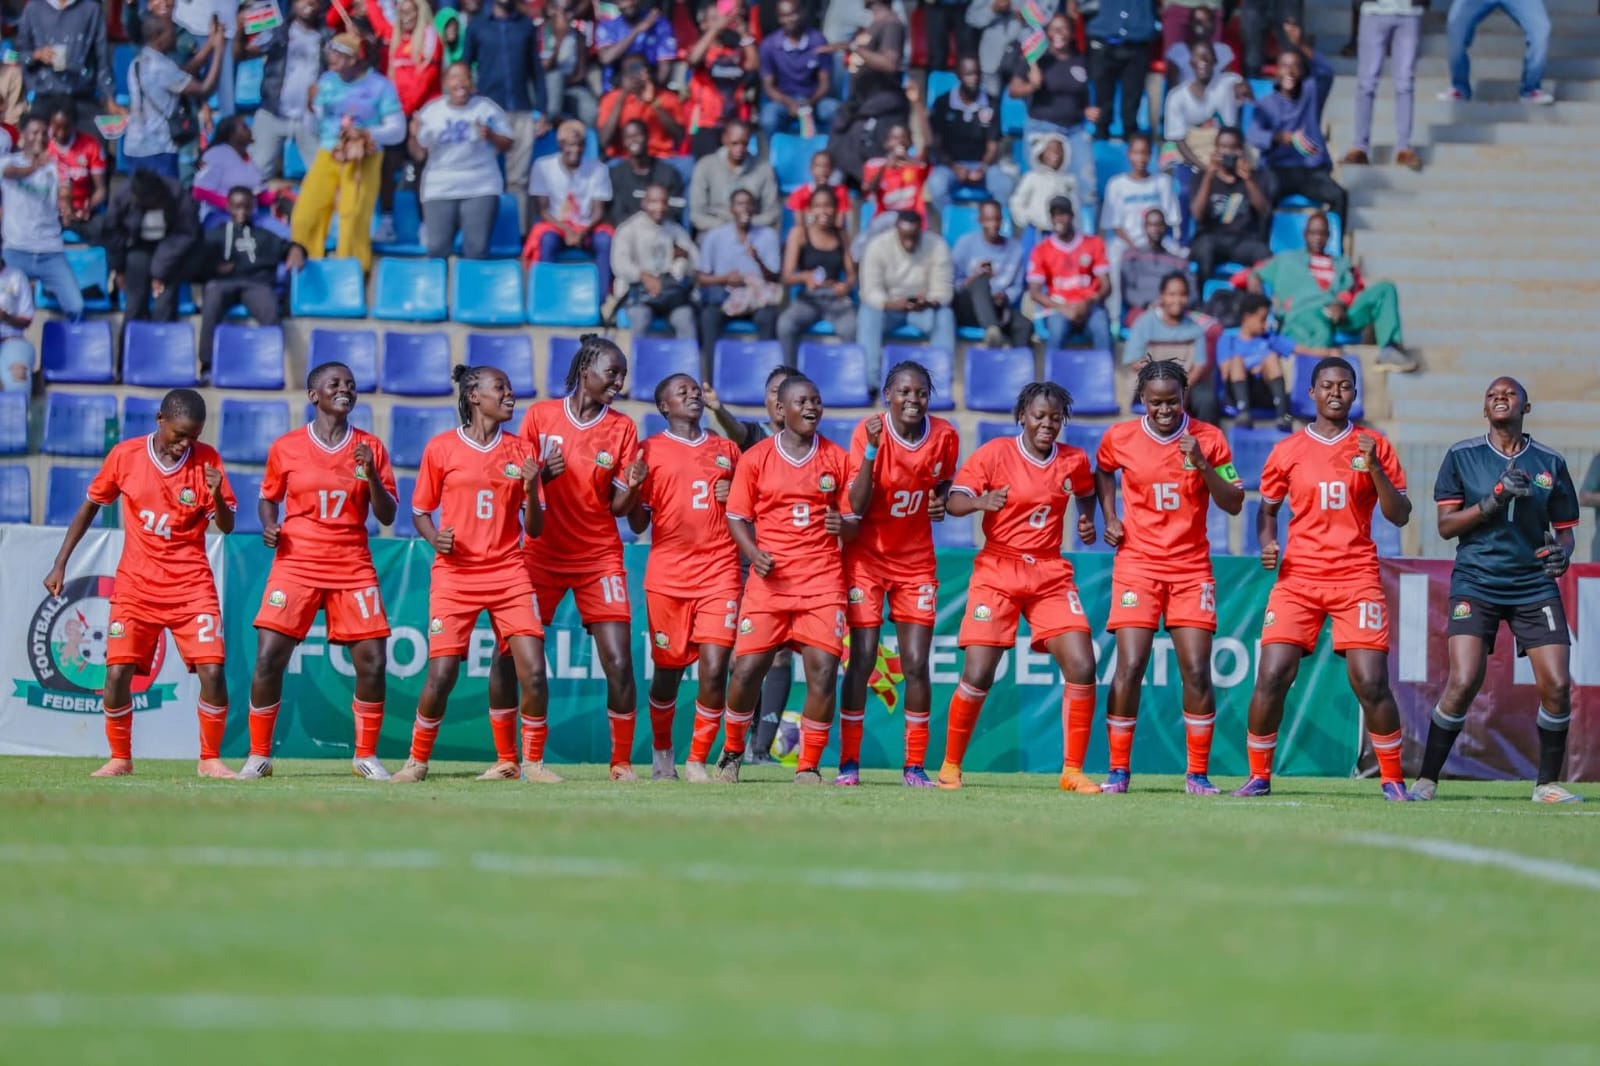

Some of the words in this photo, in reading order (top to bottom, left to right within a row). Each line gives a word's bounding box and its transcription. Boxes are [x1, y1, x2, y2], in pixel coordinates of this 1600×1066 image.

[1225, 465, 1236, 480] C
[318, 489, 347, 519] 17
[476, 489, 494, 520] 6
[691, 480, 709, 510] 2
[890, 489, 924, 517] 20
[1152, 482, 1181, 511] 15
[1318, 481, 1346, 510] 19
[139, 510, 171, 540] 24
[792, 502, 810, 526] 9
[1028, 504, 1051, 529] 8
[354, 586, 381, 619] 17
[600, 575, 626, 604] 16
[917, 584, 937, 611] 2
[1066, 590, 1084, 615] 8
[1357, 602, 1383, 631] 19
[1542, 605, 1557, 632] 1
[33, 595, 69, 680] FOOTBALL
[42, 692, 149, 713] FEDERAN
